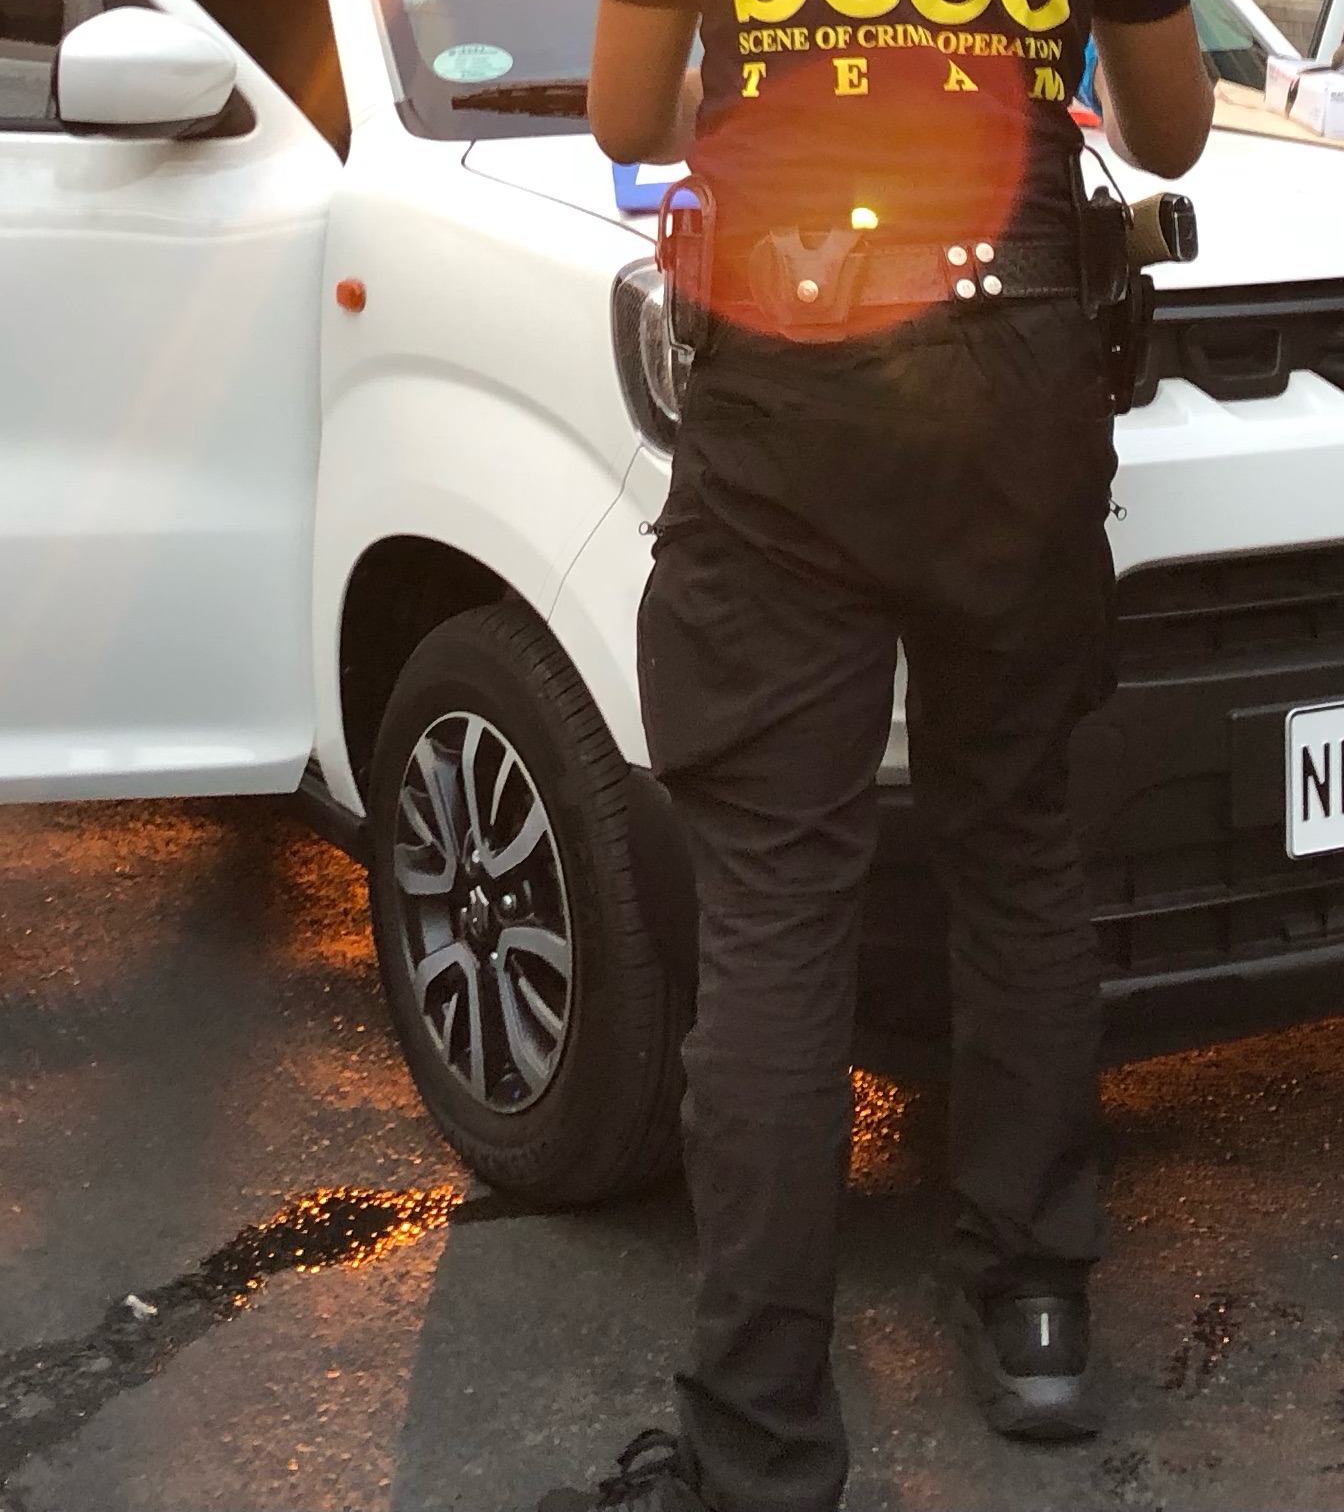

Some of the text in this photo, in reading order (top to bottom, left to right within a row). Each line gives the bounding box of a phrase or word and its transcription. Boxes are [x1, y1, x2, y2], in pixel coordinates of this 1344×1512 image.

[738, 27, 810, 56] SCENE
[815, 26, 850, 49] OF
[856, 23, 936, 50] CRIM
[741, 56, 1067, 102] TEAM
